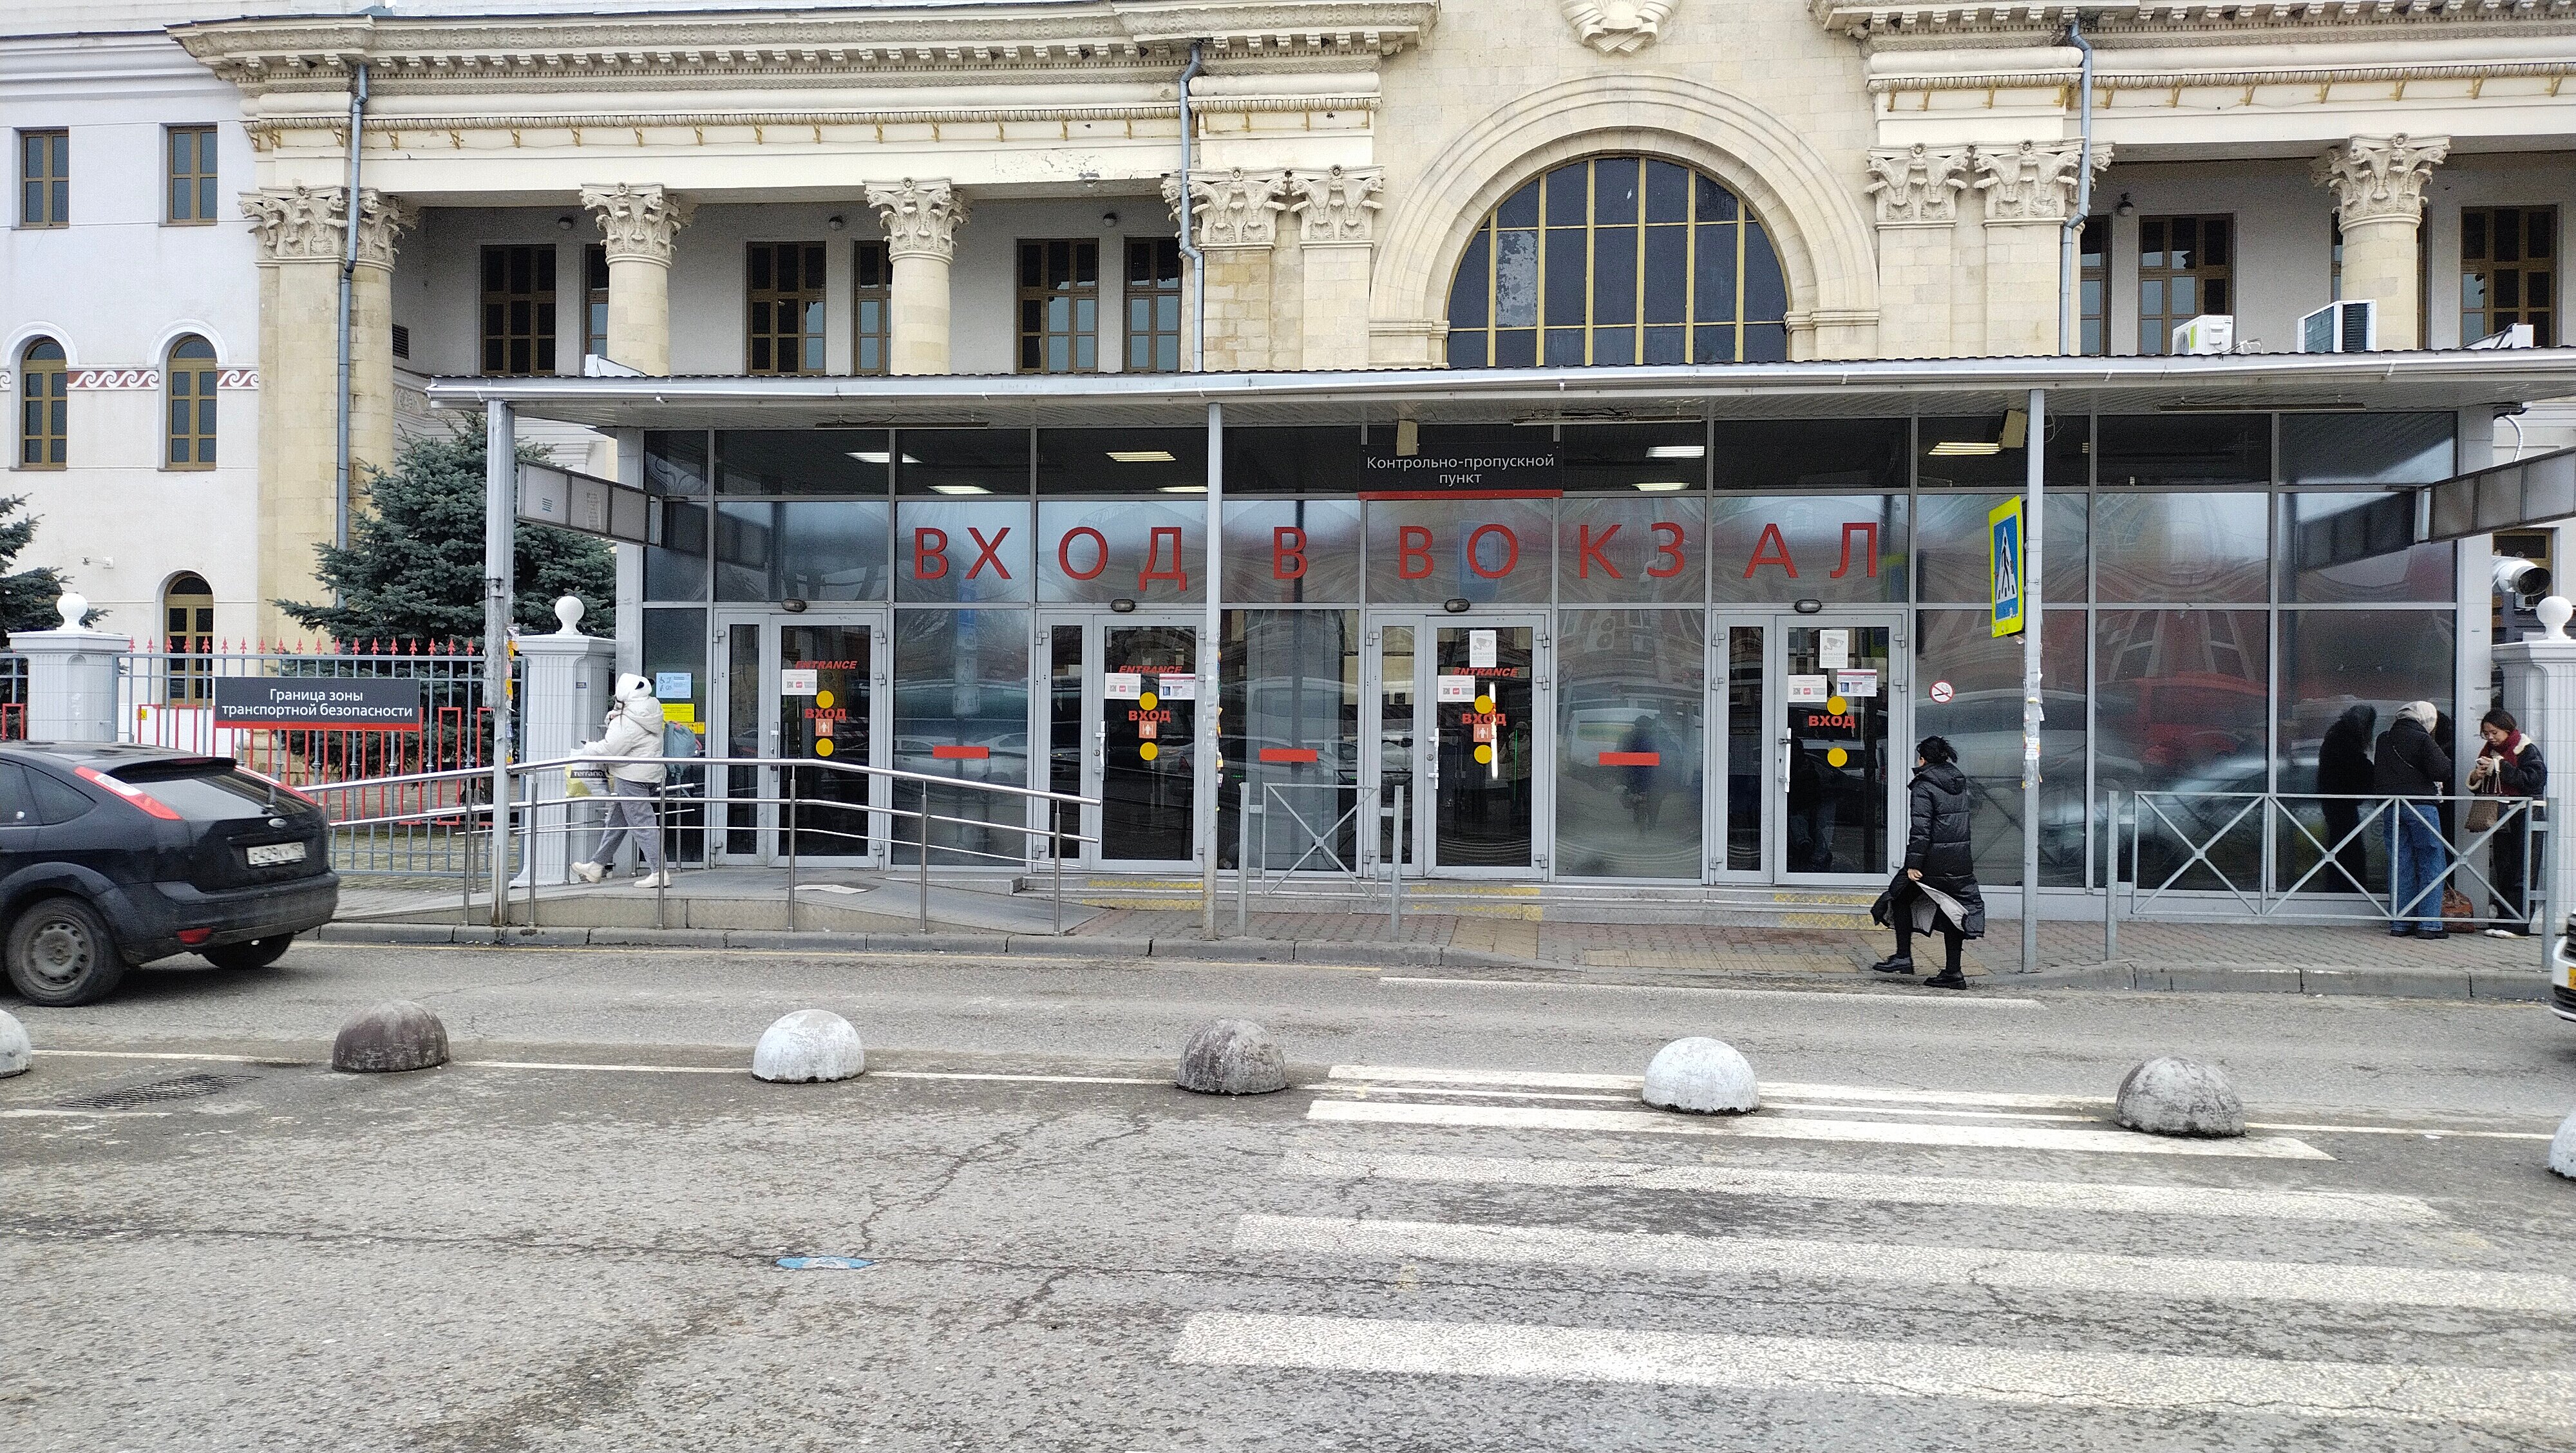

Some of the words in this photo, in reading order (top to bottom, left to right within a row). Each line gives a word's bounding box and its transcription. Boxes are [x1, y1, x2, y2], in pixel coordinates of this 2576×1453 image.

[1367, 453, 1555, 472] Контрольно-пропускной
[1439, 473, 1482, 487] пункт
[914, 527, 1188, 591] ВХОД
[1273, 526, 1308, 580] В
[1399, 522, 1877, 579] ВОКЗАЛ
[795, 661, 858, 669] ENTRANCE
[1453, 667, 1519, 676] ENTRANCE
[270, 689, 325, 703] Граница
[329, 691, 363, 701] зоны
[222, 704, 316, 717] транспортной
[320, 703, 412, 717] безопасности
[804, 708, 846, 721] ВХОД
[1128, 710, 1171, 723] ВХОД
[1463, 714, 1506, 726] ВХОД
[1808, 716, 1855, 728] ВХОД
